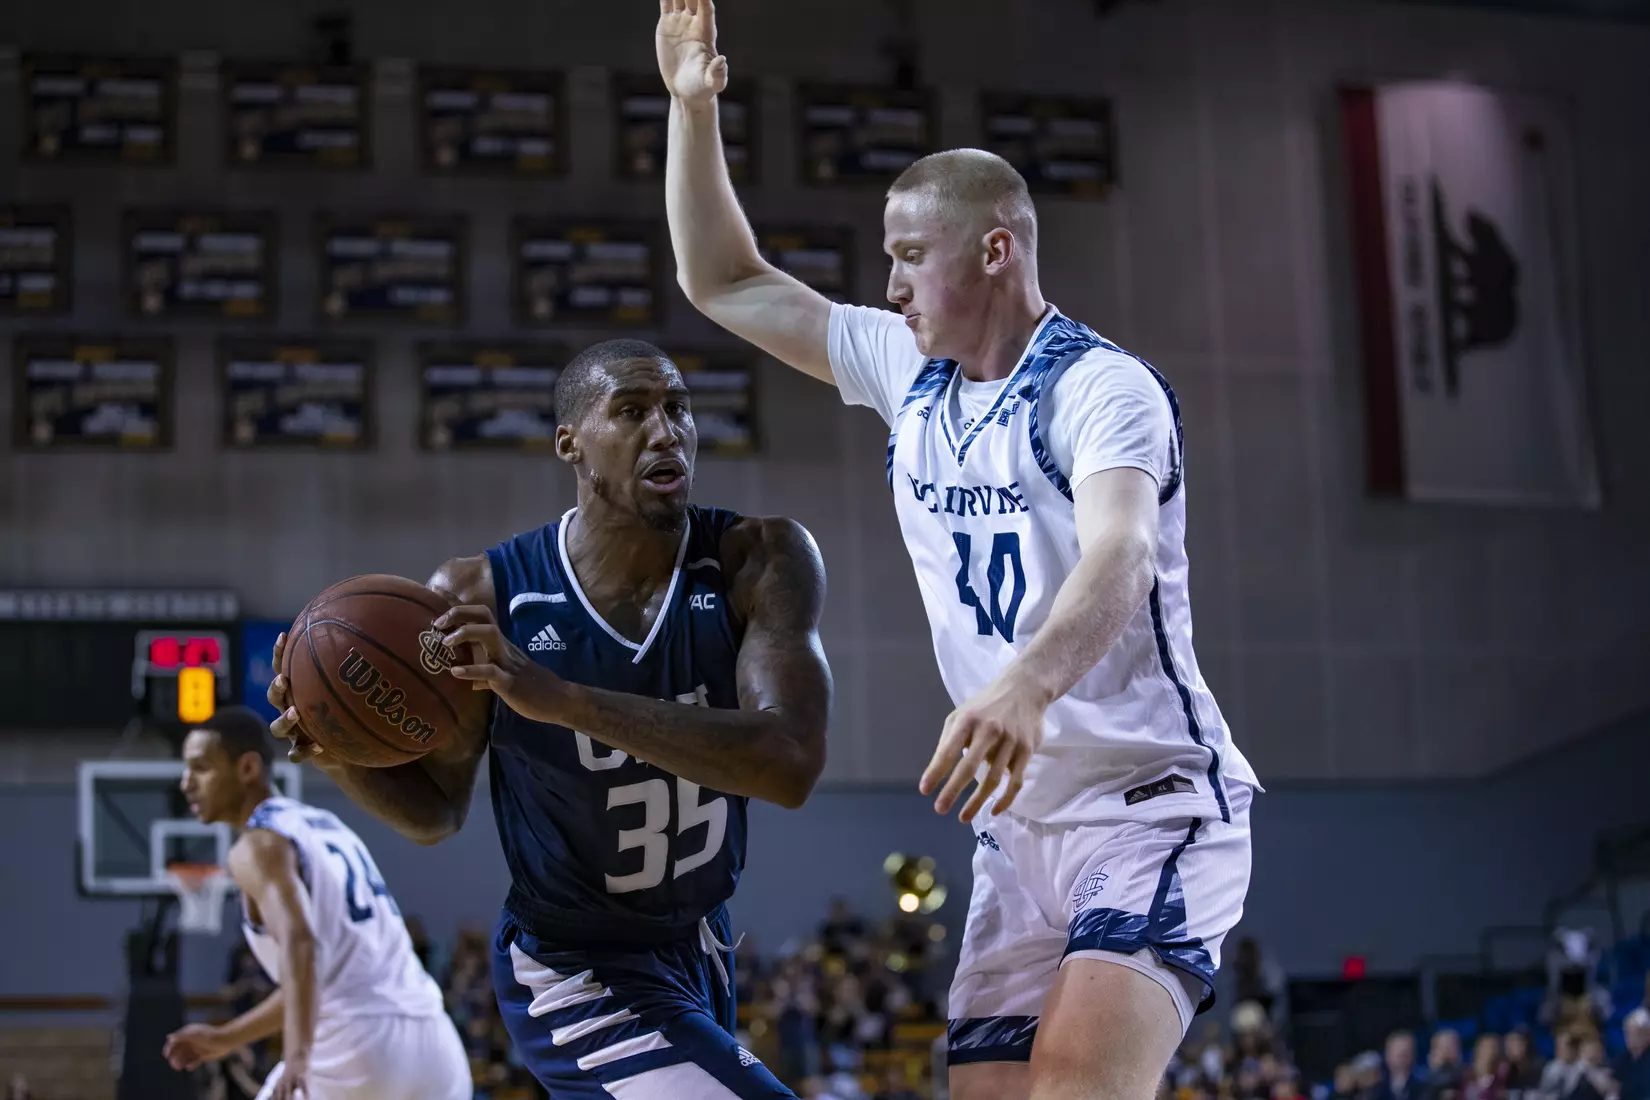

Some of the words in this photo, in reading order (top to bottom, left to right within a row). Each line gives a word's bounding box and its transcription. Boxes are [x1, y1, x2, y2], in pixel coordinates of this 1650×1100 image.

[528, 640, 567, 651] adidas
[338, 646, 438, 744] Wilson
[604, 776, 728, 894] 35
